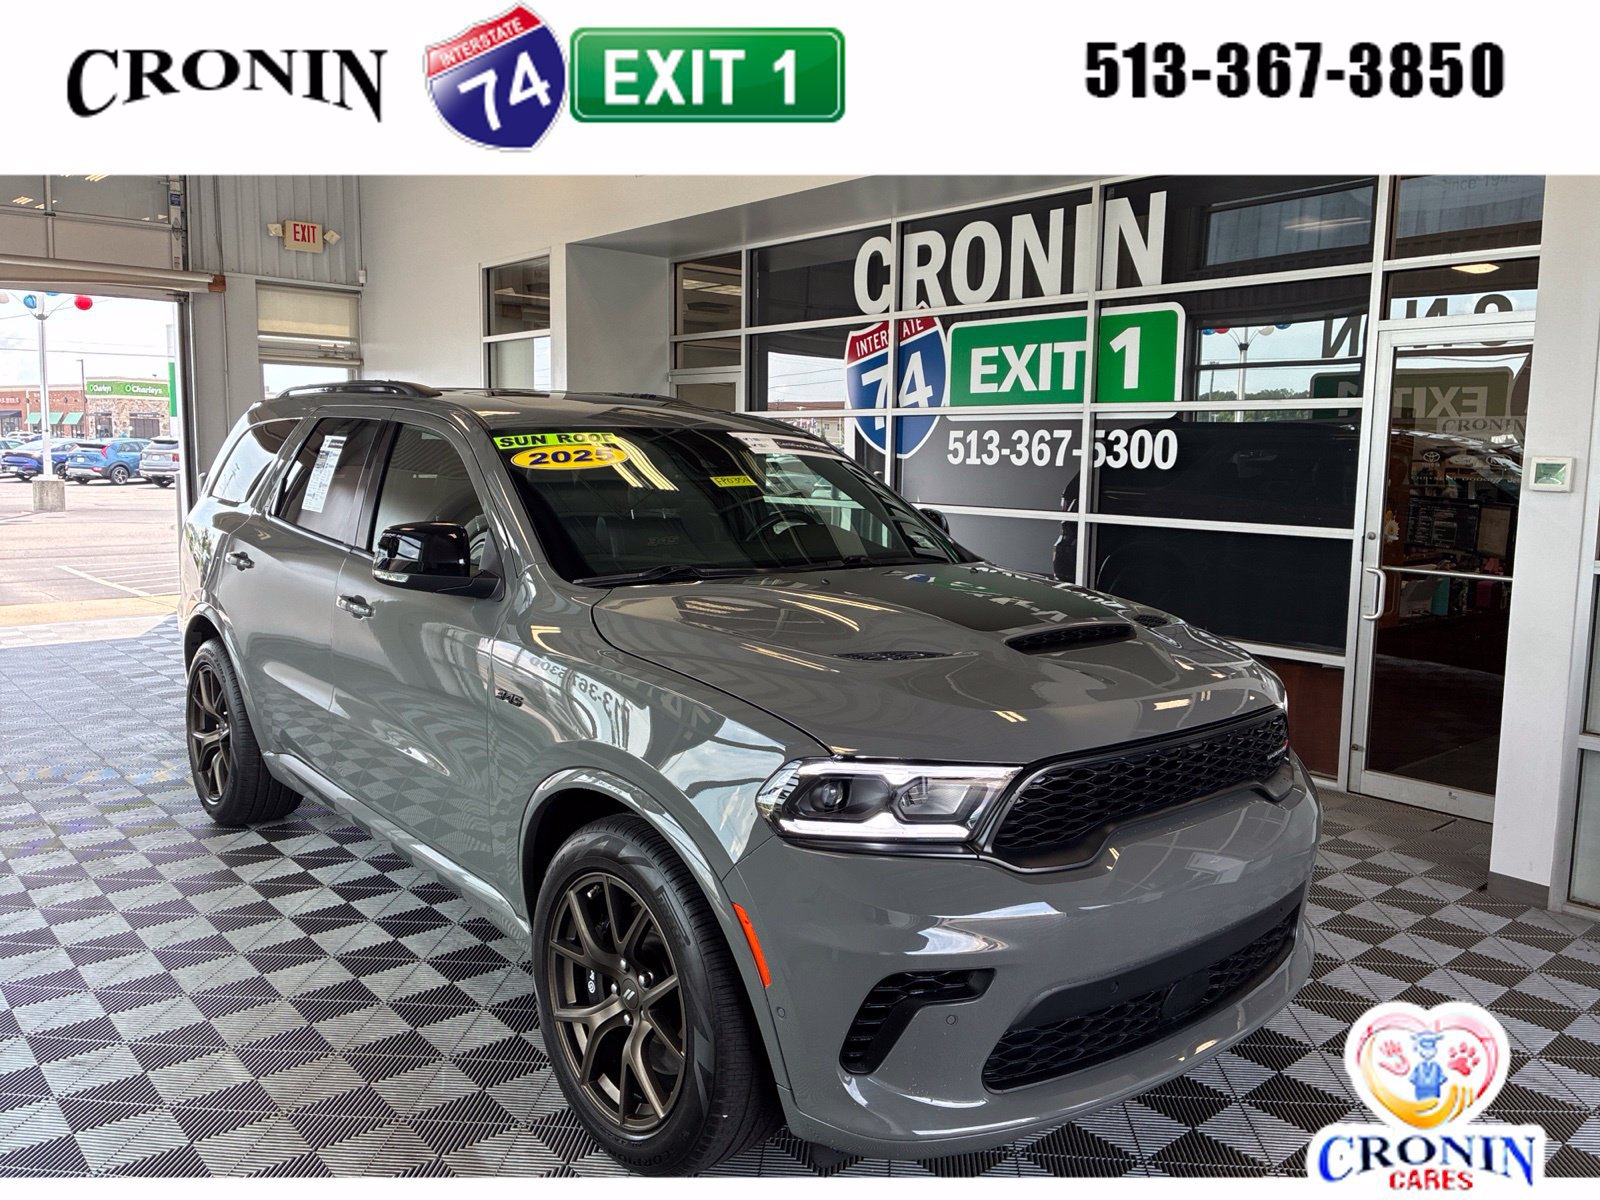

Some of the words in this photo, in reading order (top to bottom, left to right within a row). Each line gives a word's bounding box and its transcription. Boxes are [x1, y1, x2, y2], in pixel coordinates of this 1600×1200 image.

[293, 223, 317, 244] EXIT
[853, 190, 1168, 315] CRONIN
[855, 316, 924, 358] INTERATE
[969, 340, 1087, 394] EXIT
[1109, 326, 1141, 390] 1
[861, 350, 934, 431] 74
[499, 434, 547, 447] SUN
[556, 432, 613, 443] ROOF
[528, 448, 614, 466] 2025
[947, 428, 1179, 471] 513-367-5300
